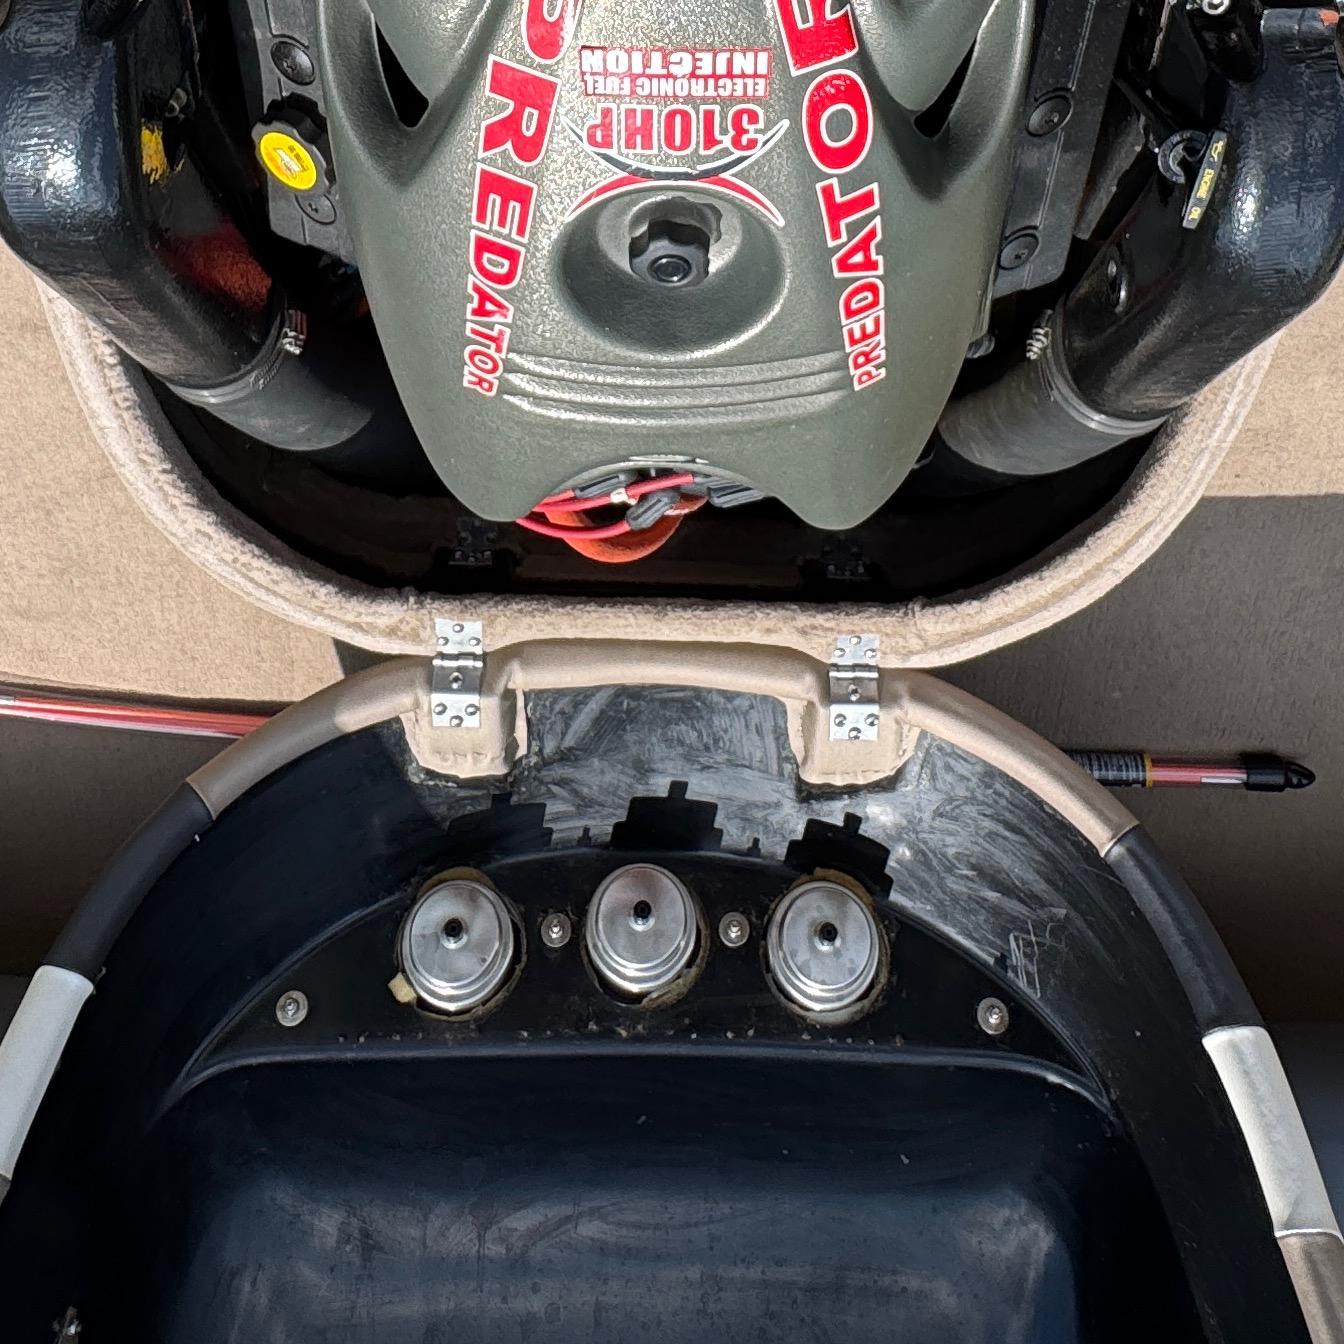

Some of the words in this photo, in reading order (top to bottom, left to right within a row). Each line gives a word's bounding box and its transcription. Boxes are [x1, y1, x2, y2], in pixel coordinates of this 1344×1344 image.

[581, 49, 769, 76] INJECTION
[584, 73, 631, 96] FUEL
[635, 76, 766, 97] ELECTRONIC
[584, 104, 764, 154] 310HP
